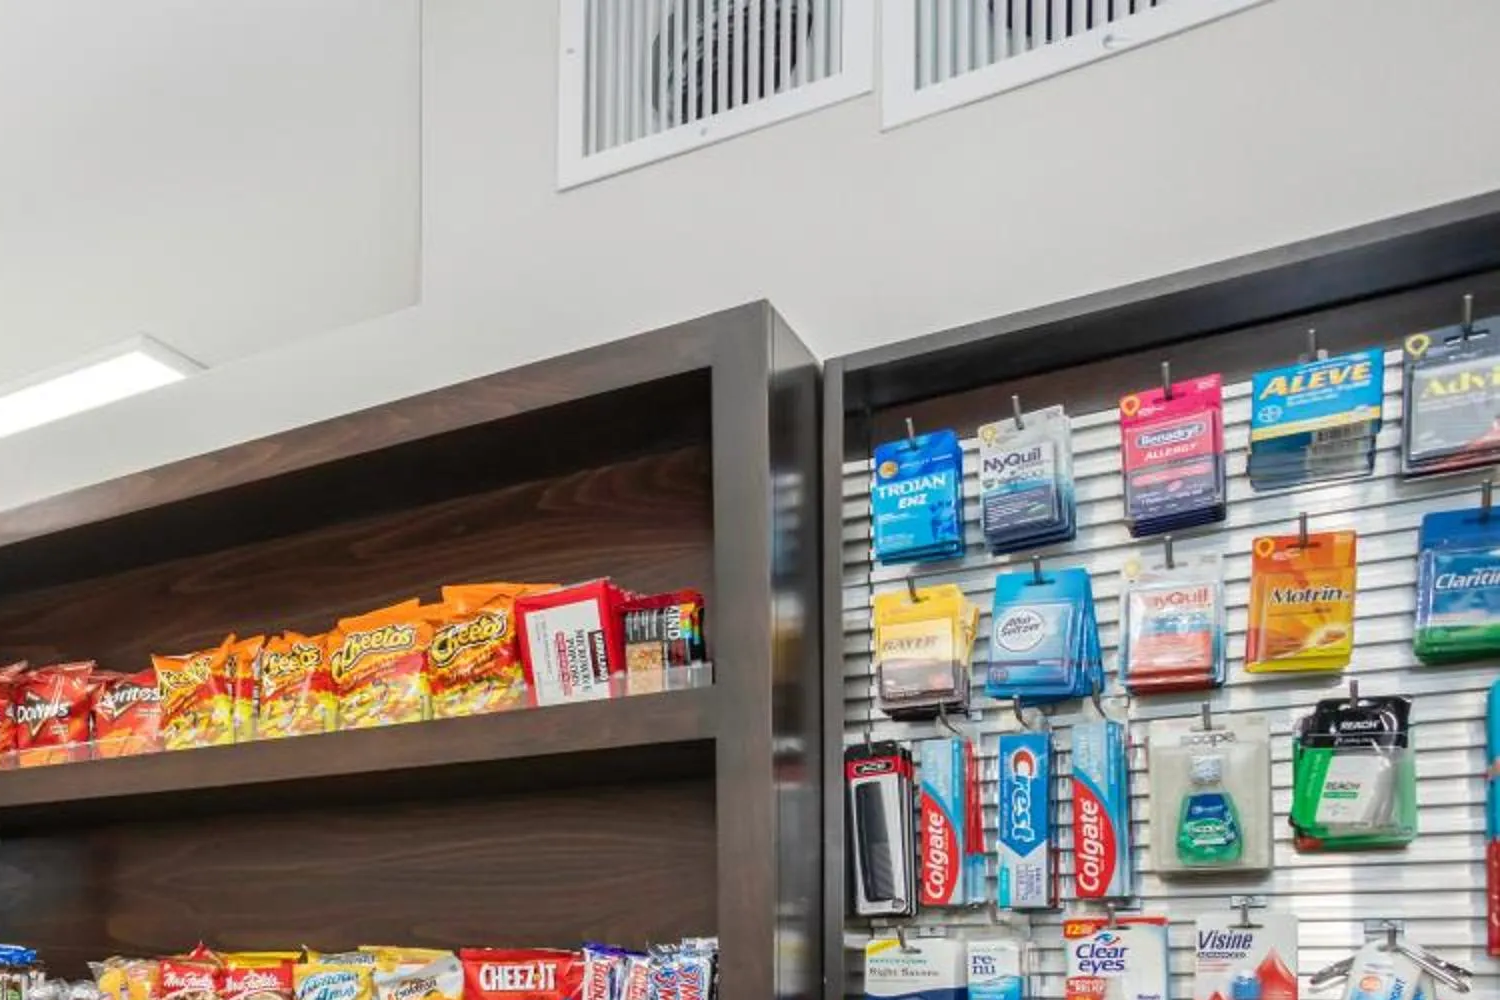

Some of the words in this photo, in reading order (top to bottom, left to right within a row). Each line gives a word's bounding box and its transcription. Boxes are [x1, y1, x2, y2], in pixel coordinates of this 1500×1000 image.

[1260, 363, 1372, 400] ALEVE
[983, 447, 1041, 473] NyQuil
[878, 474, 945, 498] TROJAN
[899, 494, 927, 509] ENZ
[1270, 586, 1343, 604] Motrin
[666, 605, 682, 639] KIND
[331, 624, 414, 680] Cheetos
[16, 701, 68, 723] Doritos
[1340, 720, 1381, 731] REACH
[1010, 750, 1036, 844] Crest
[924, 811, 949, 899] Colgate
[1078, 799, 1106, 891] Colgate
[1076, 943, 1129, 959] Clear
[1198, 929, 1254, 951] Visine
[972, 963, 996, 975] nu
[1079, 959, 1125, 976] eyes
